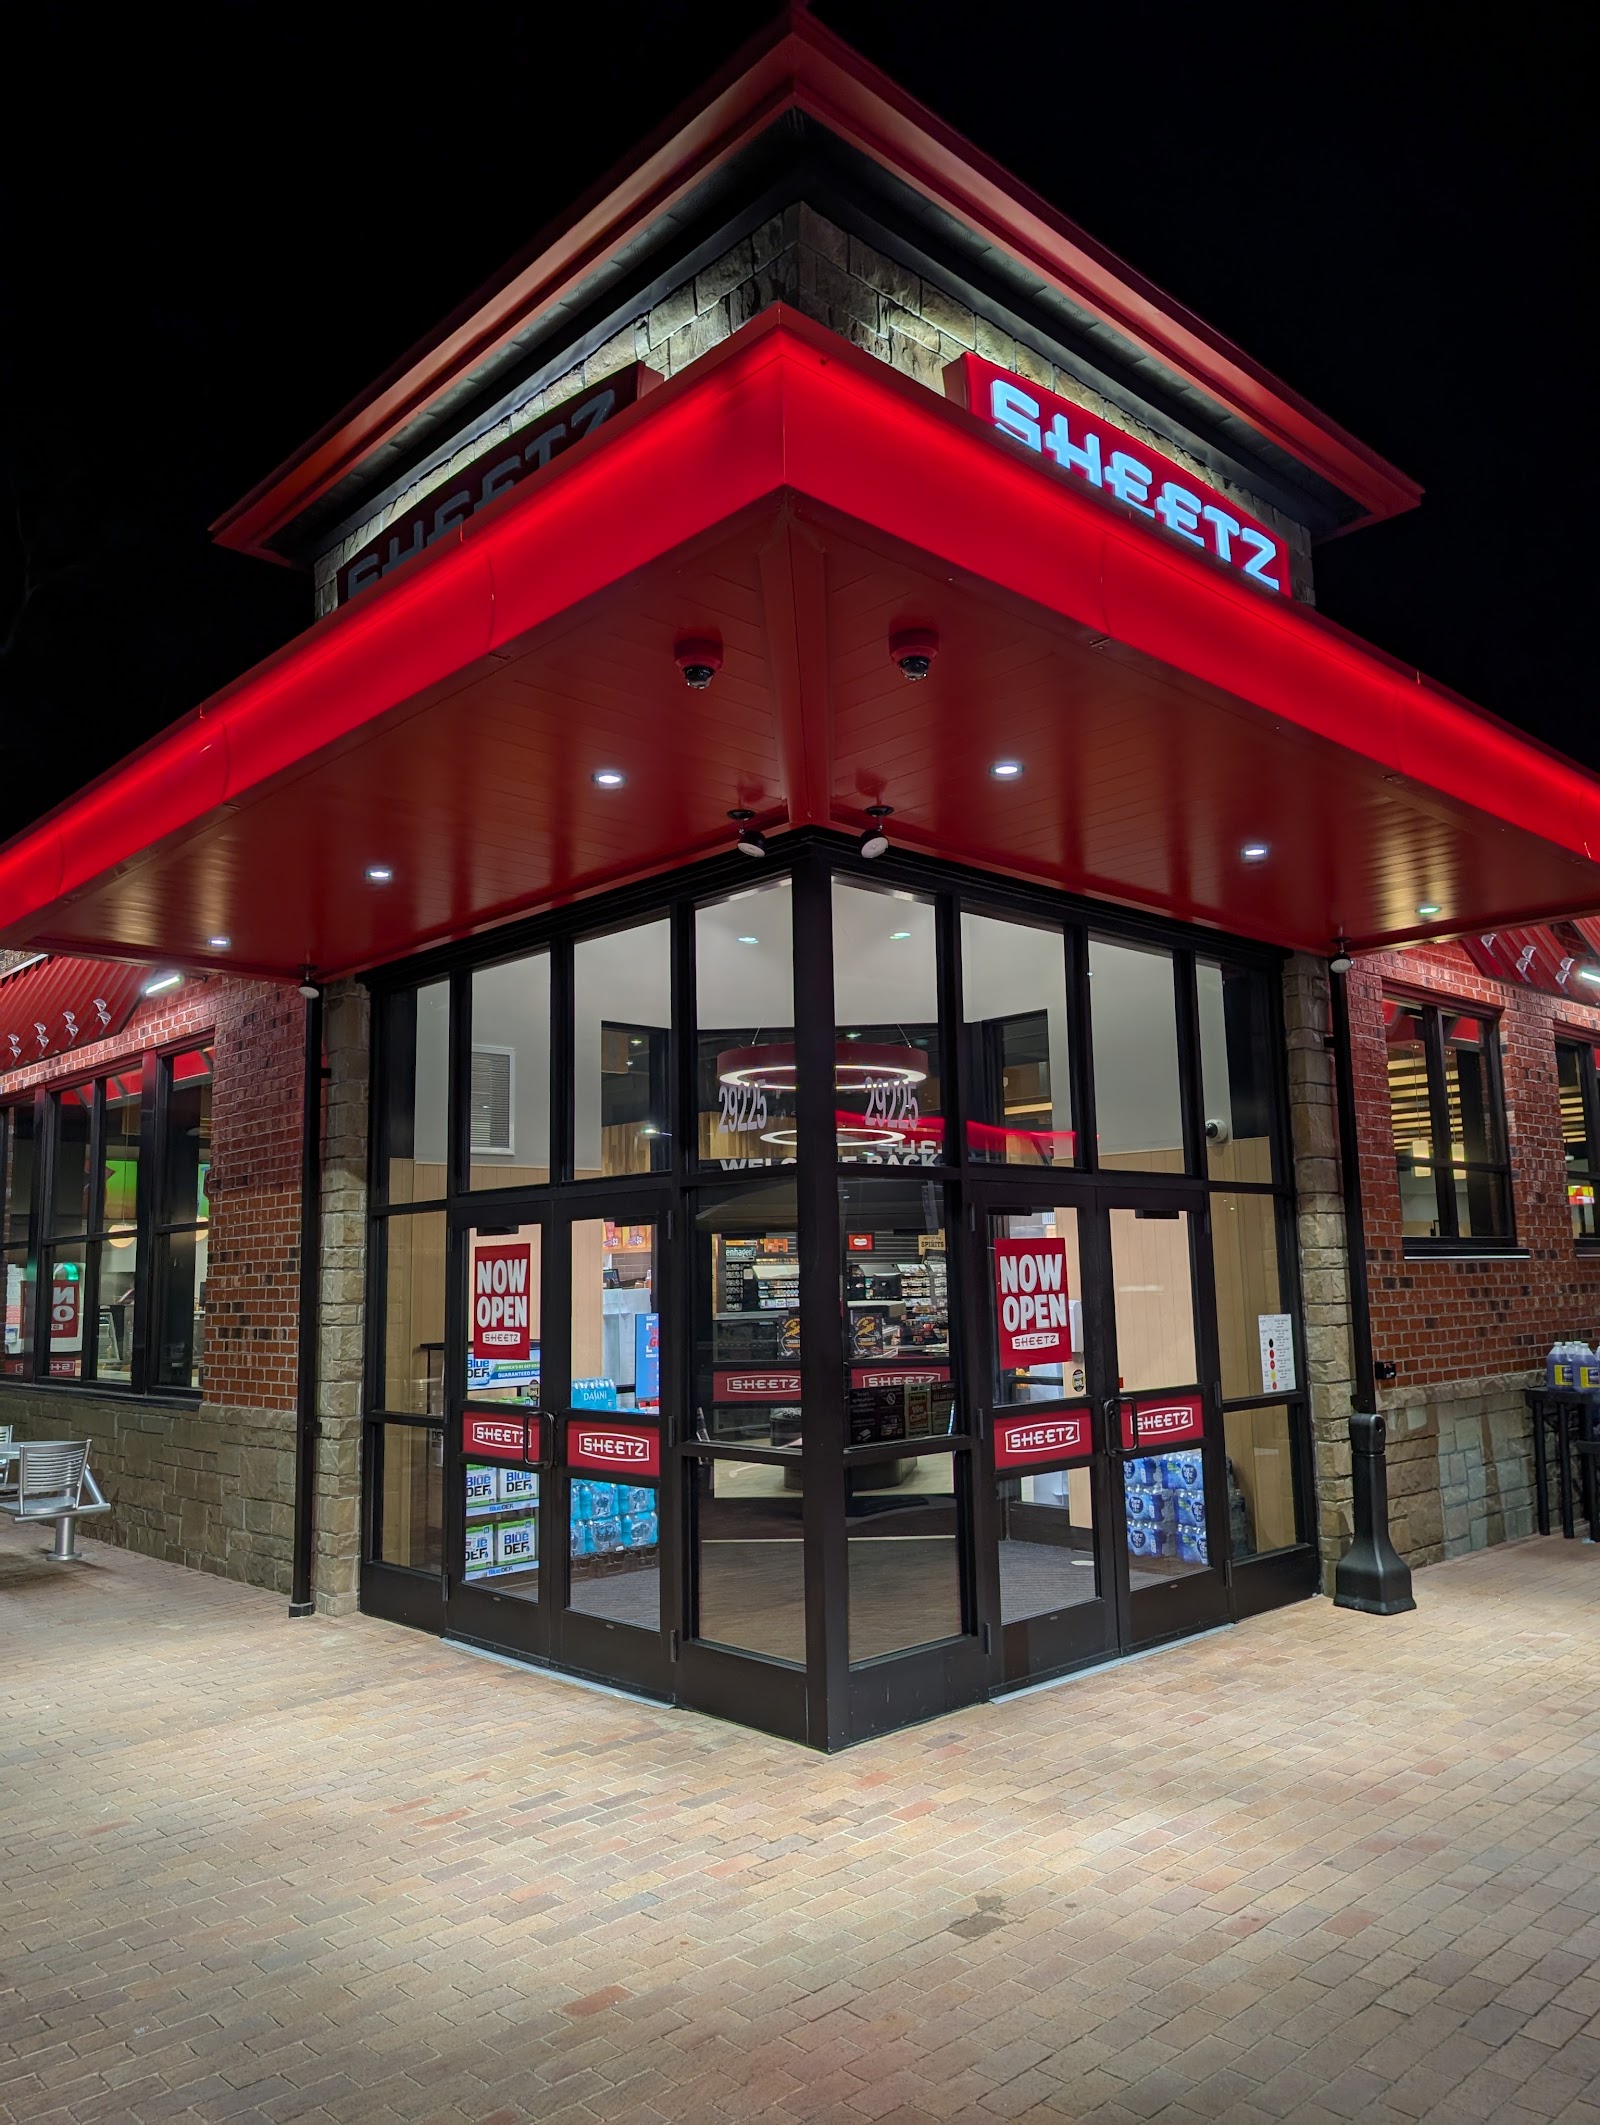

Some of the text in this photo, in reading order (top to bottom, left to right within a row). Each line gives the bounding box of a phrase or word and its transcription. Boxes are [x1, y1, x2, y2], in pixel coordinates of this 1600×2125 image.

[990, 379, 1280, 591] SHEETZ
[718, 1079, 767, 1134] 29225
[864, 1076, 919, 1130] 29225
[476, 1258, 527, 1294] NOW
[1000, 1254, 1063, 1294] NOW
[476, 1296, 527, 1329] OPEN
[1002, 1293, 1068, 1332] OPEN
[484, 1333, 519, 1343] SHEETZ
[1014, 1335, 1057, 1348] SHEETZ
[732, 1378, 799, 1390] SHEETZ
[583, 1437, 644, 1457] SHEETZ
[1011, 1425, 1076, 1449] SHEETZ
[466, 1484, 491, 1498] DEF
[506, 1480, 531, 1493] DEF
[504, 1532, 529, 1544] Blue
[504, 1542, 529, 1556] DEF
